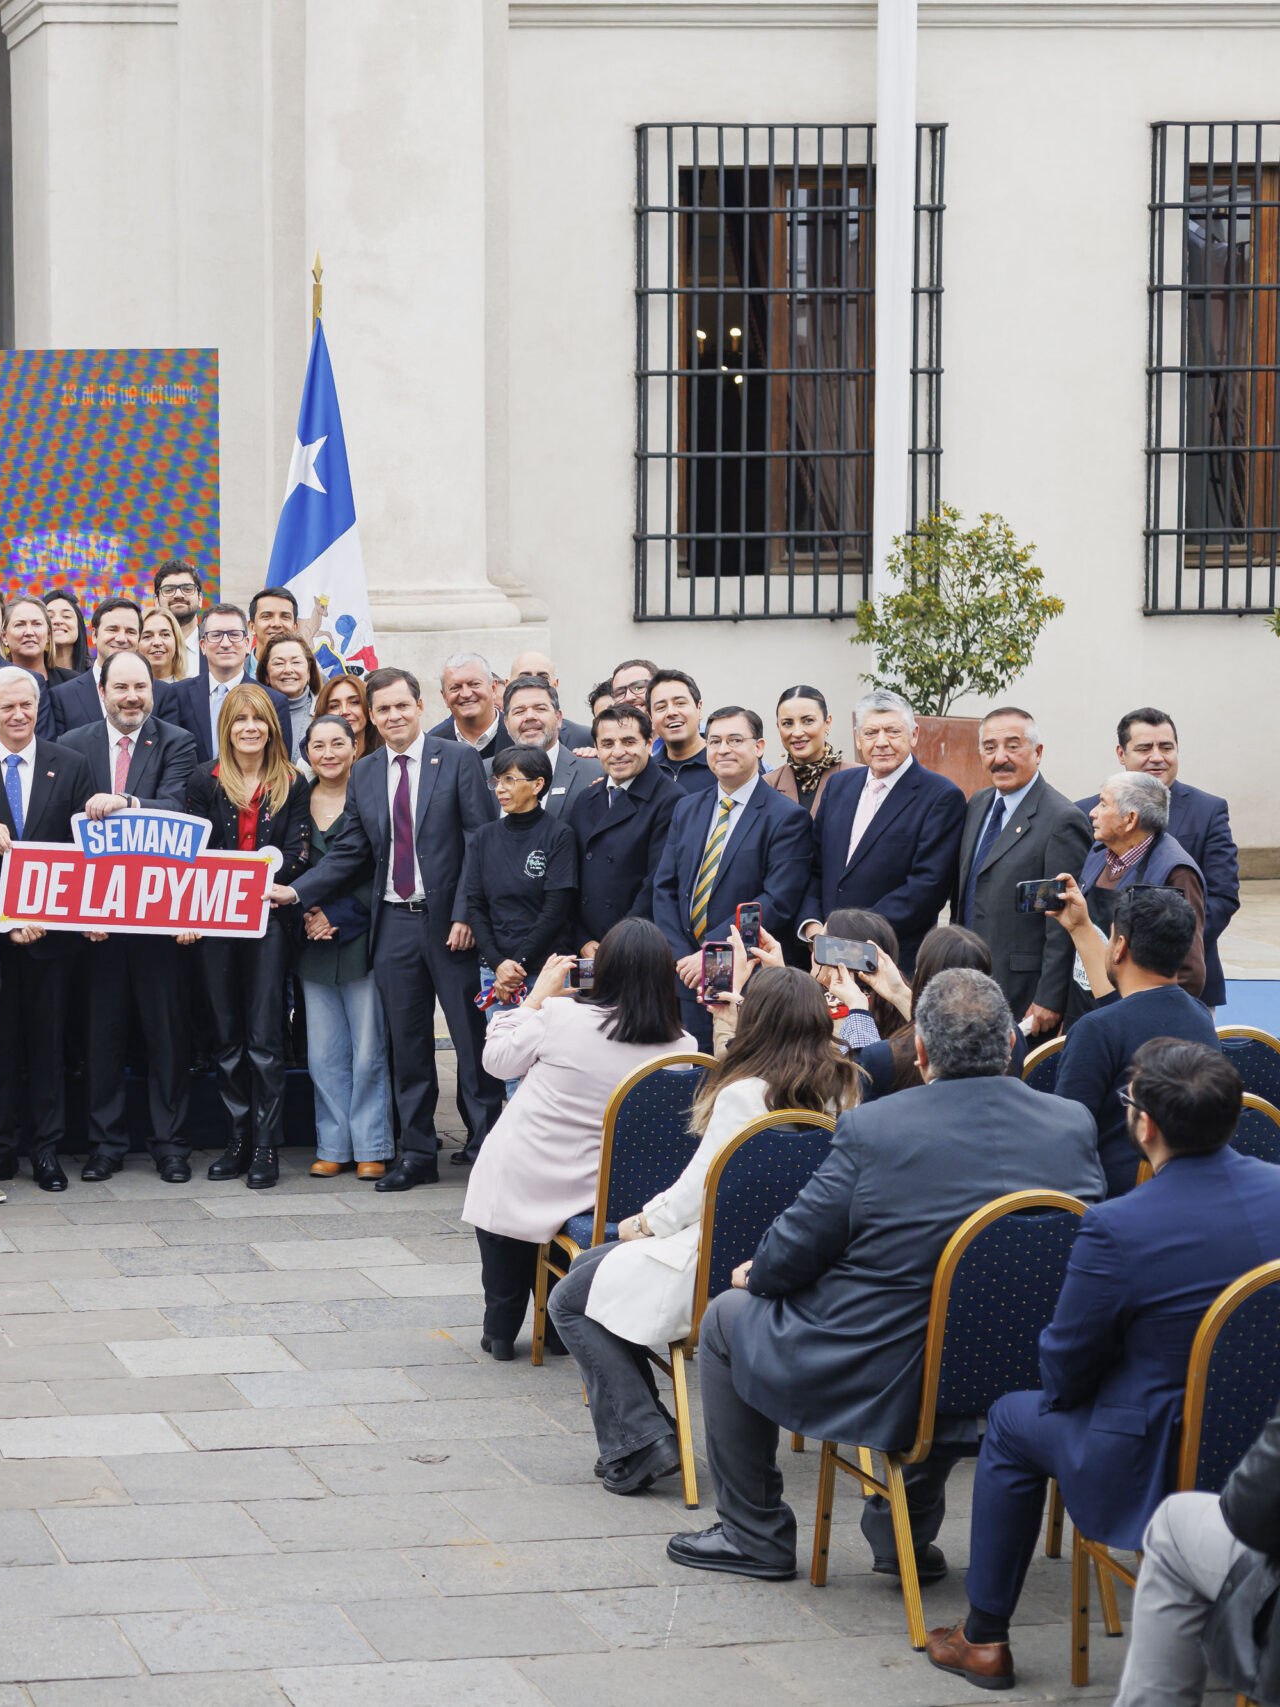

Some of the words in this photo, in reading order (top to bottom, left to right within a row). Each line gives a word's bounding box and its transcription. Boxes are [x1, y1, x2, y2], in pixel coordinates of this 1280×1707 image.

[17, 531, 119, 576] SEMANA
[86, 818, 194, 858] SEMANA
[16, 861, 74, 916] DE
[79, 863, 126, 918] LA
[135, 866, 255, 923] PYME
